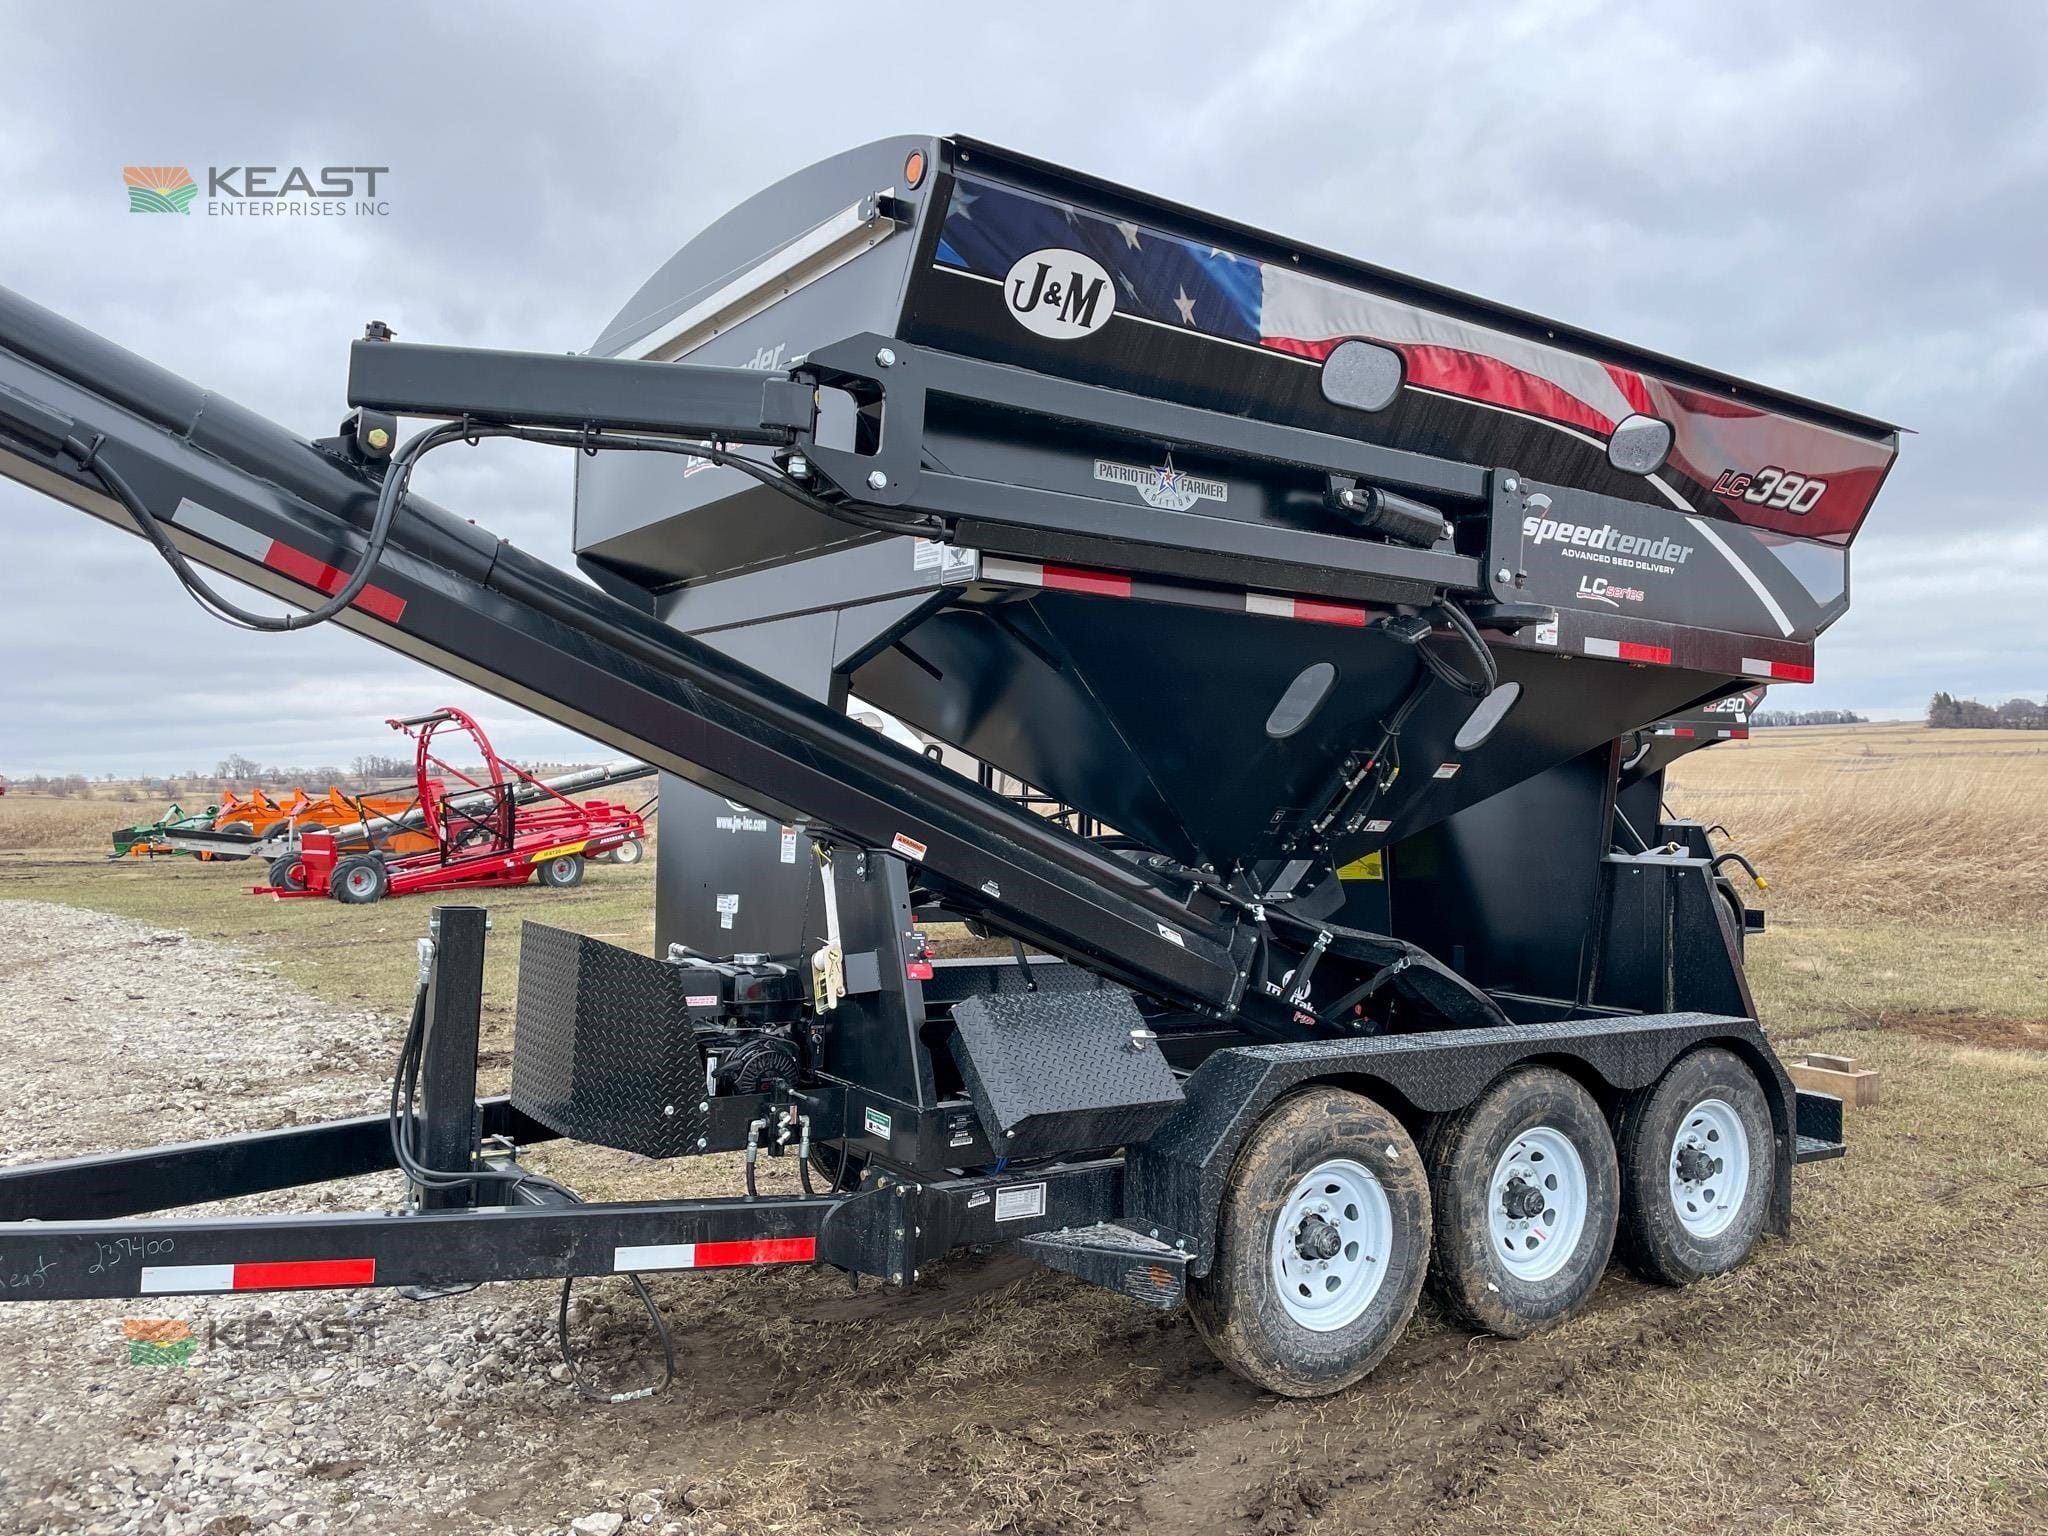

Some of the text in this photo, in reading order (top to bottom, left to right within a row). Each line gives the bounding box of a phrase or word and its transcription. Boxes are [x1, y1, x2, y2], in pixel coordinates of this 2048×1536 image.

[1012, 262, 1106, 328] J&M
[1099, 463, 1224, 499] PATRIOTIC FARMER
[1143, 487, 1192, 508] EDITION
[1560, 547, 1676, 576] ADVANCED SEED DELIVERY
